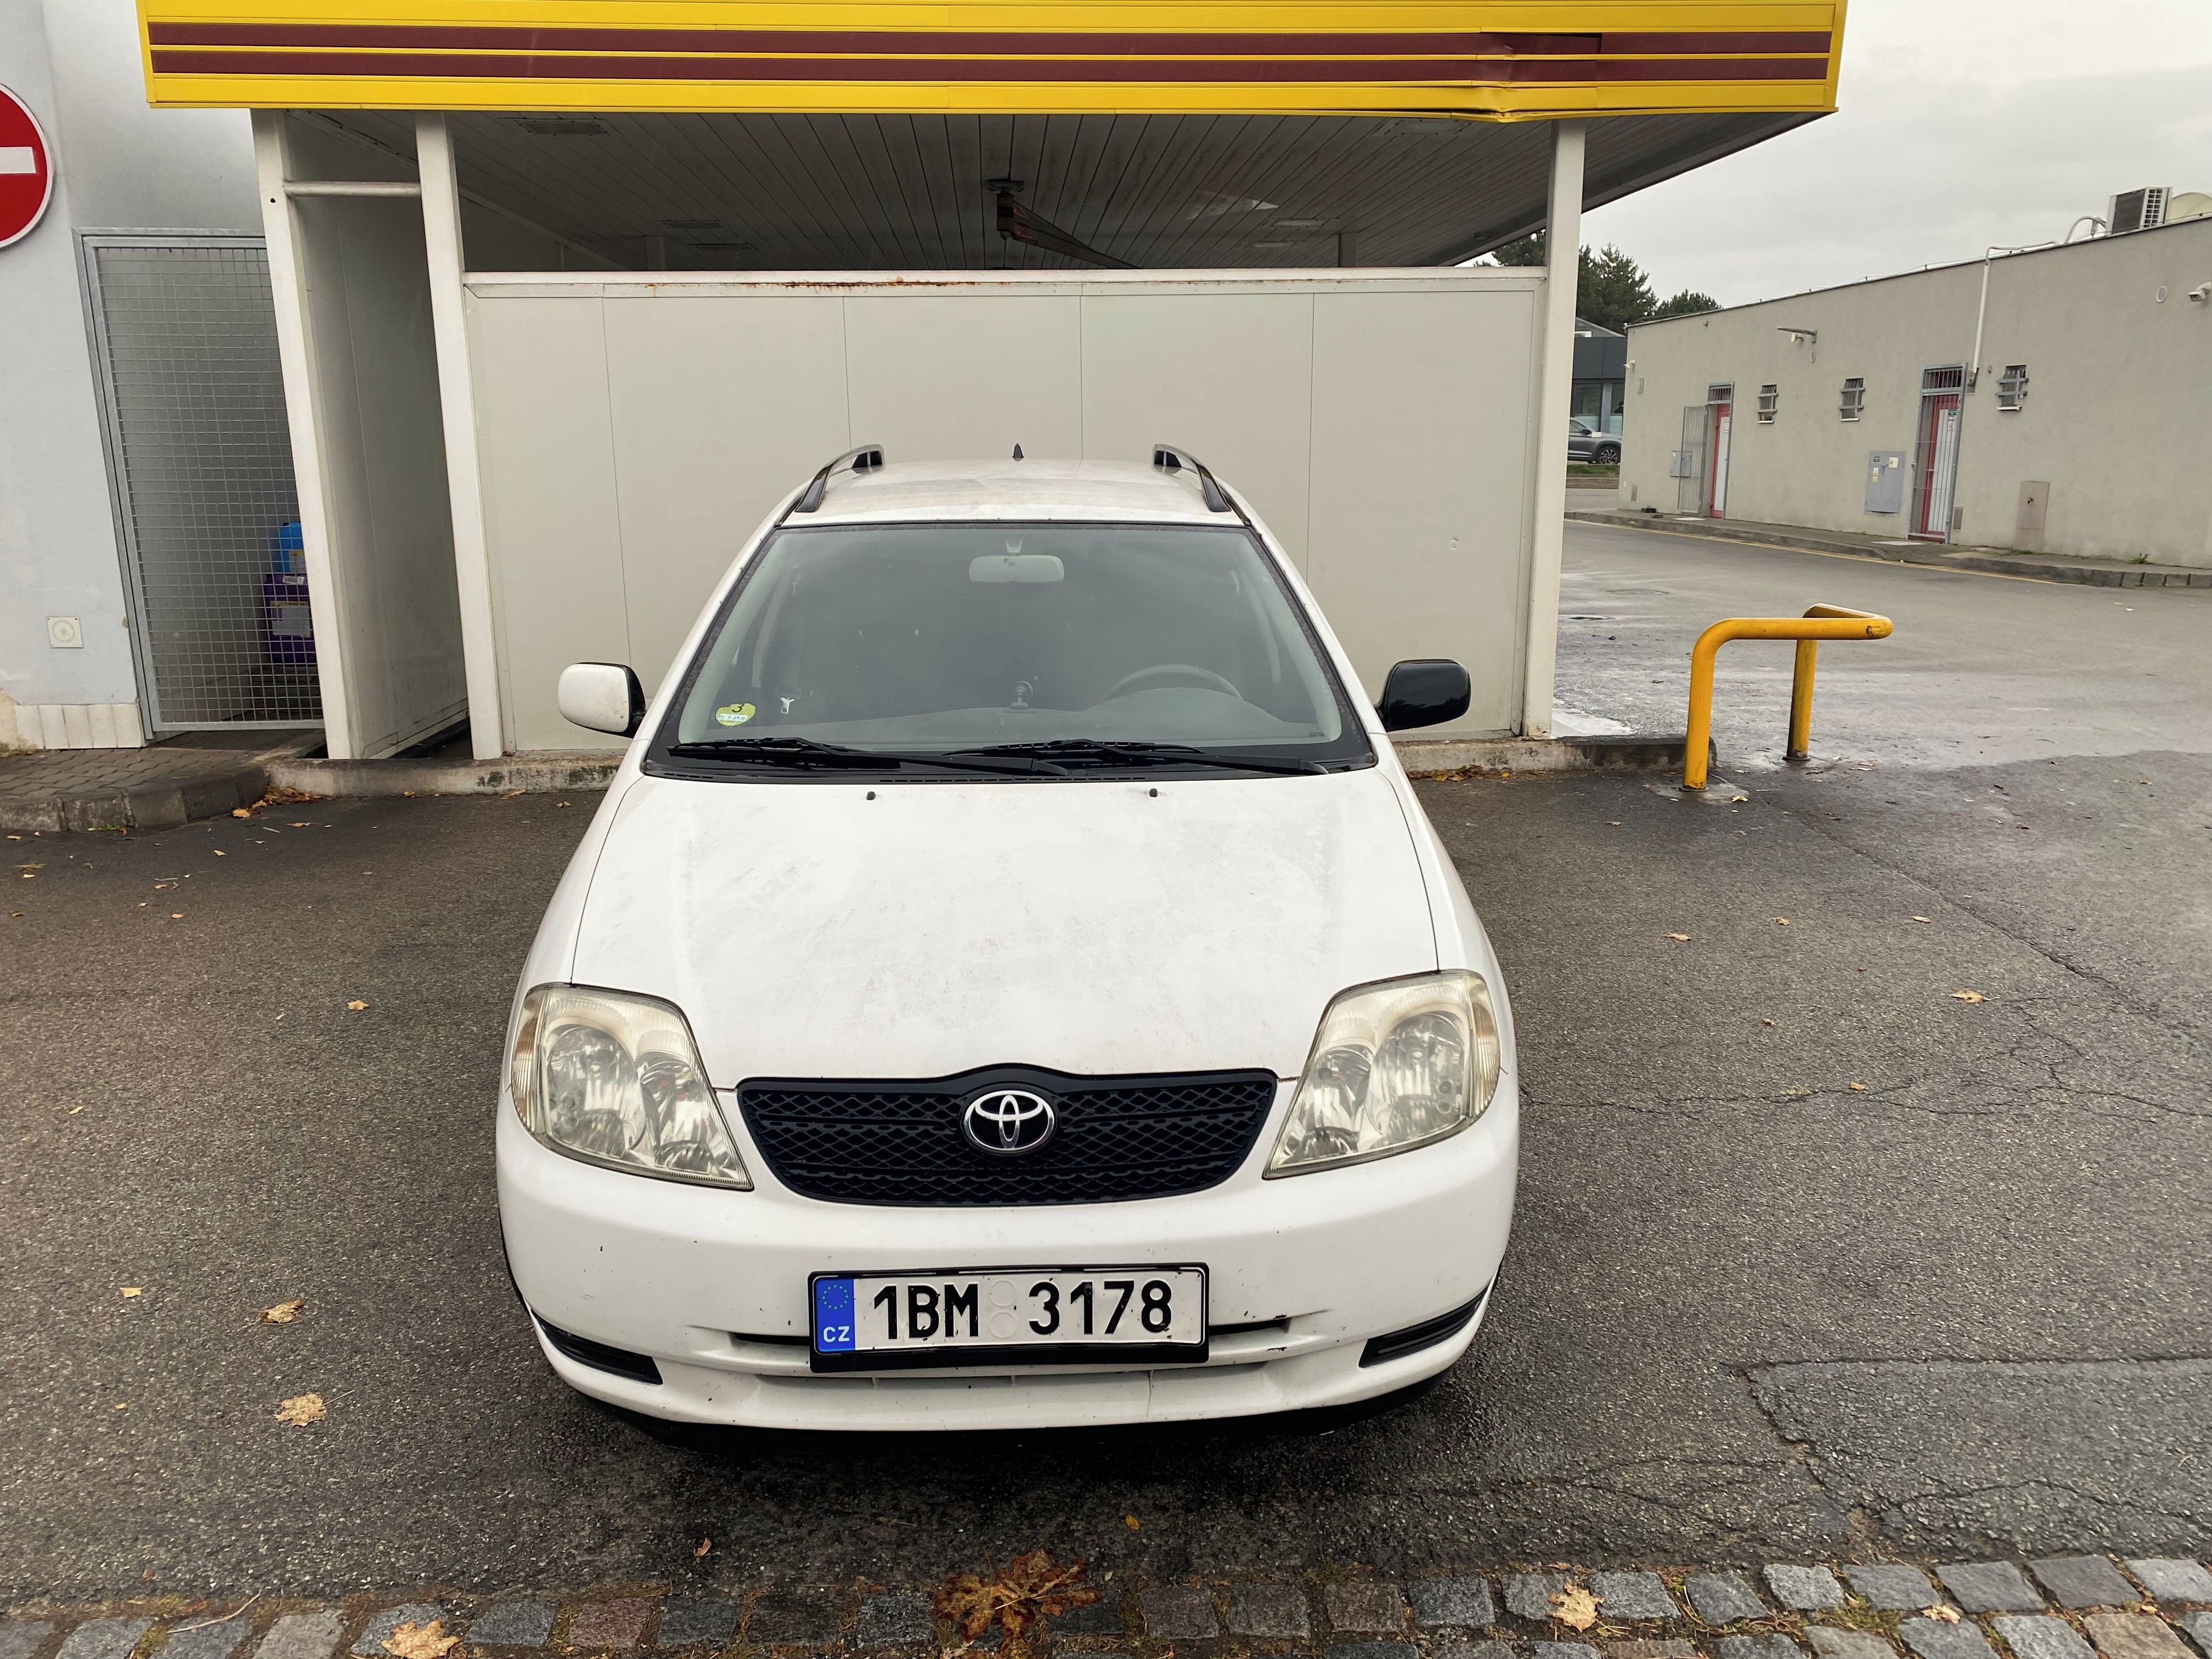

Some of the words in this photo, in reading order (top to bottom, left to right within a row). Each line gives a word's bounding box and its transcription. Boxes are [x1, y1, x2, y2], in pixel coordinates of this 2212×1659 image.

[874, 1283, 979, 1340] 1BM
[1029, 1280, 1172, 1335] 3178
[823, 1325, 850, 1342] CZ
